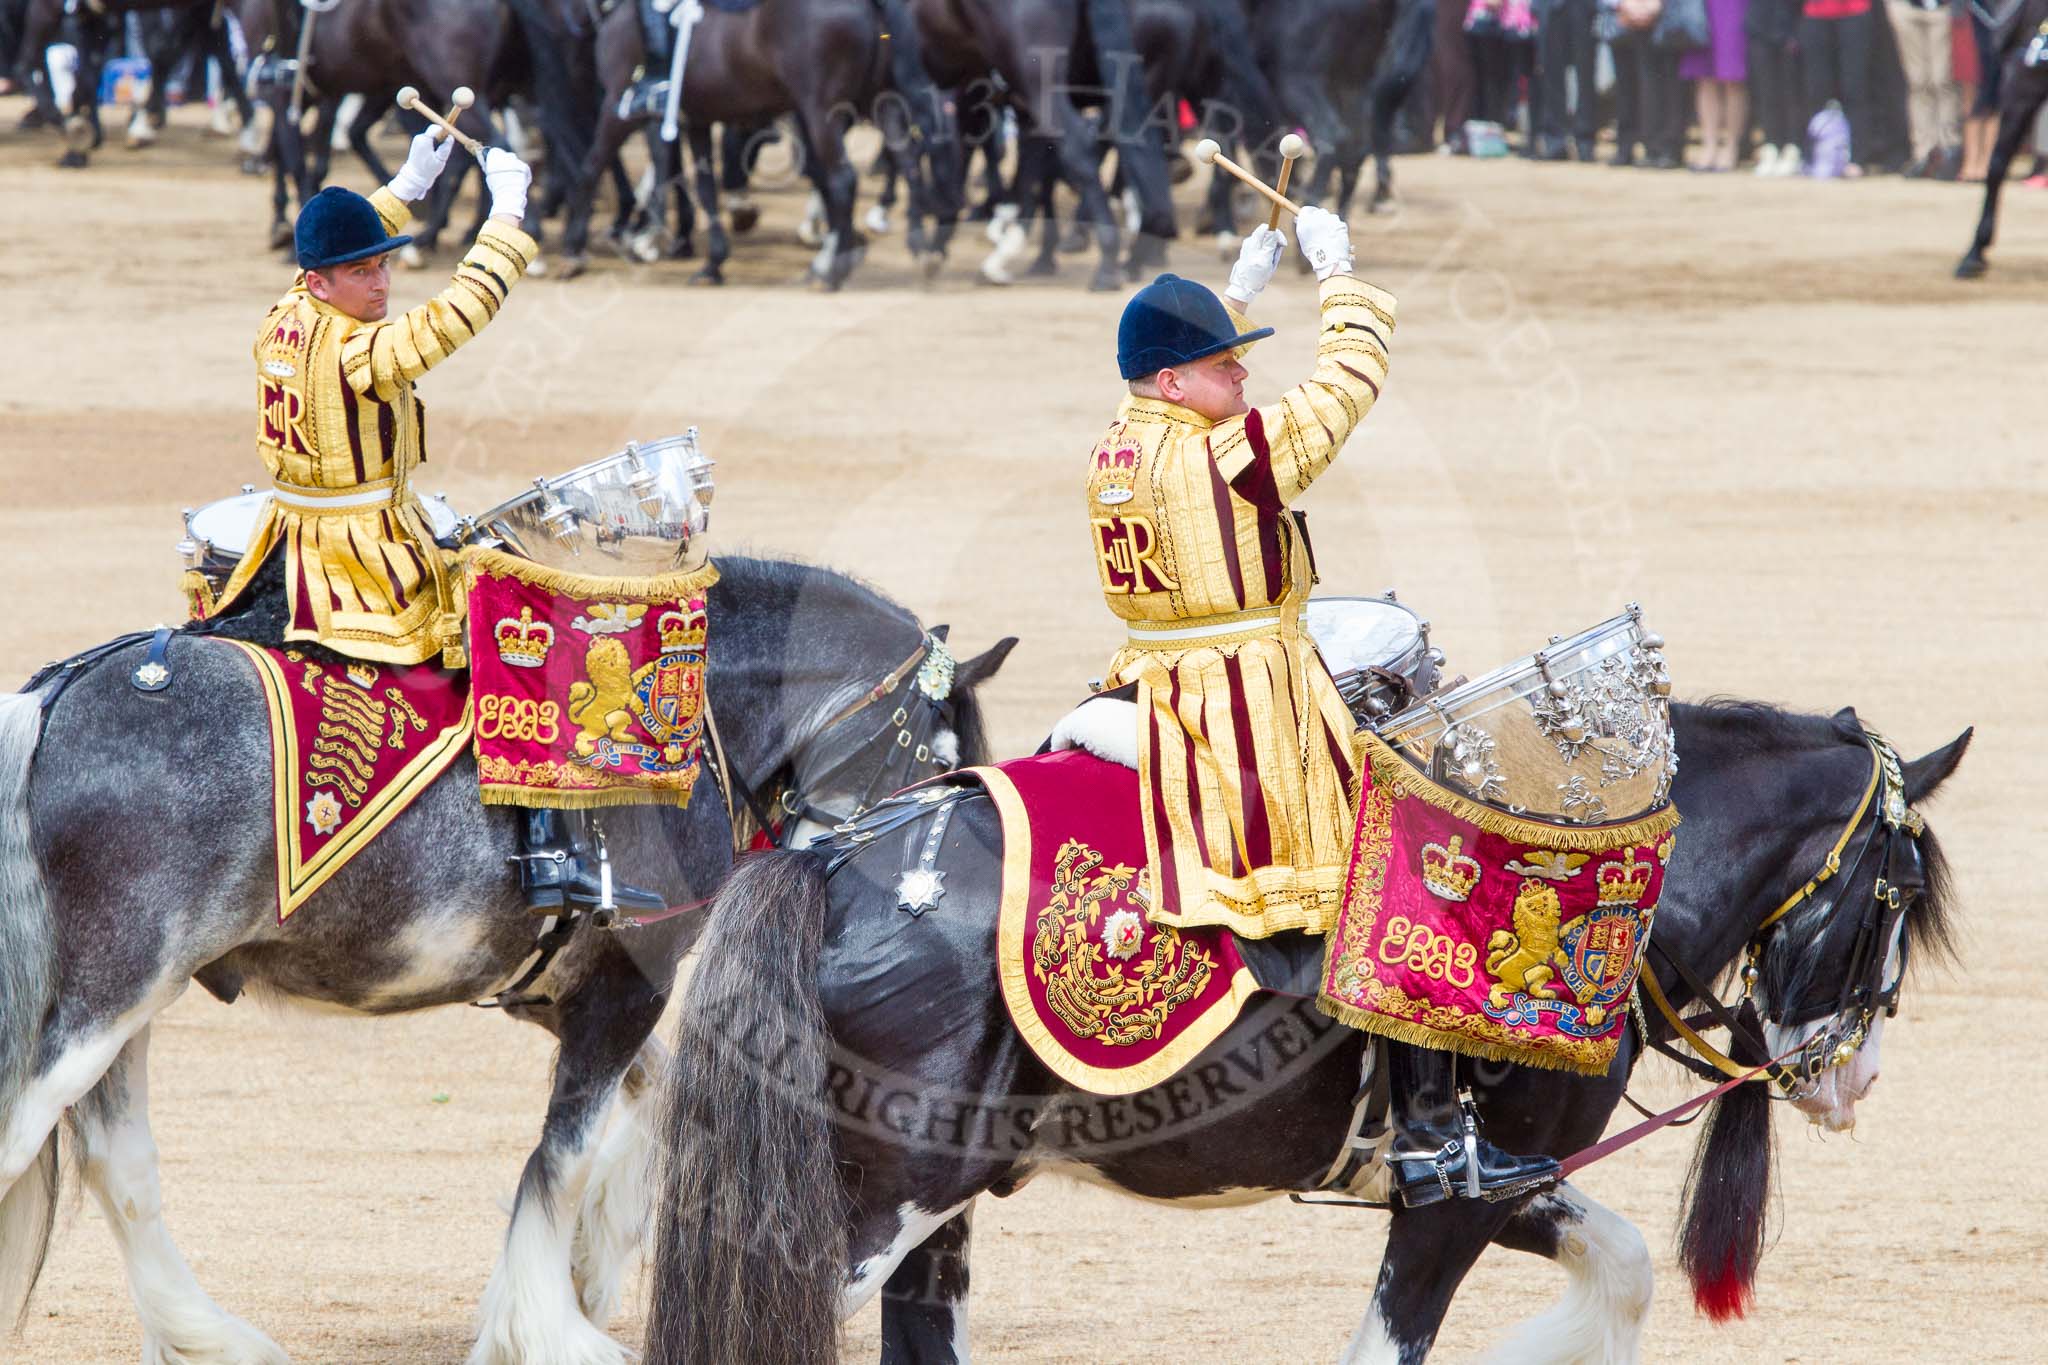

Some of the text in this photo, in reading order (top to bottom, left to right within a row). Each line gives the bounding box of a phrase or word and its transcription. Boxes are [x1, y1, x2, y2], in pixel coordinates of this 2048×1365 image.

[1155, 934, 1170, 977] WATERLOO
[1175, 983, 1195, 1002] AISNE
[1530, 999, 1574, 1015] DIEU ET
